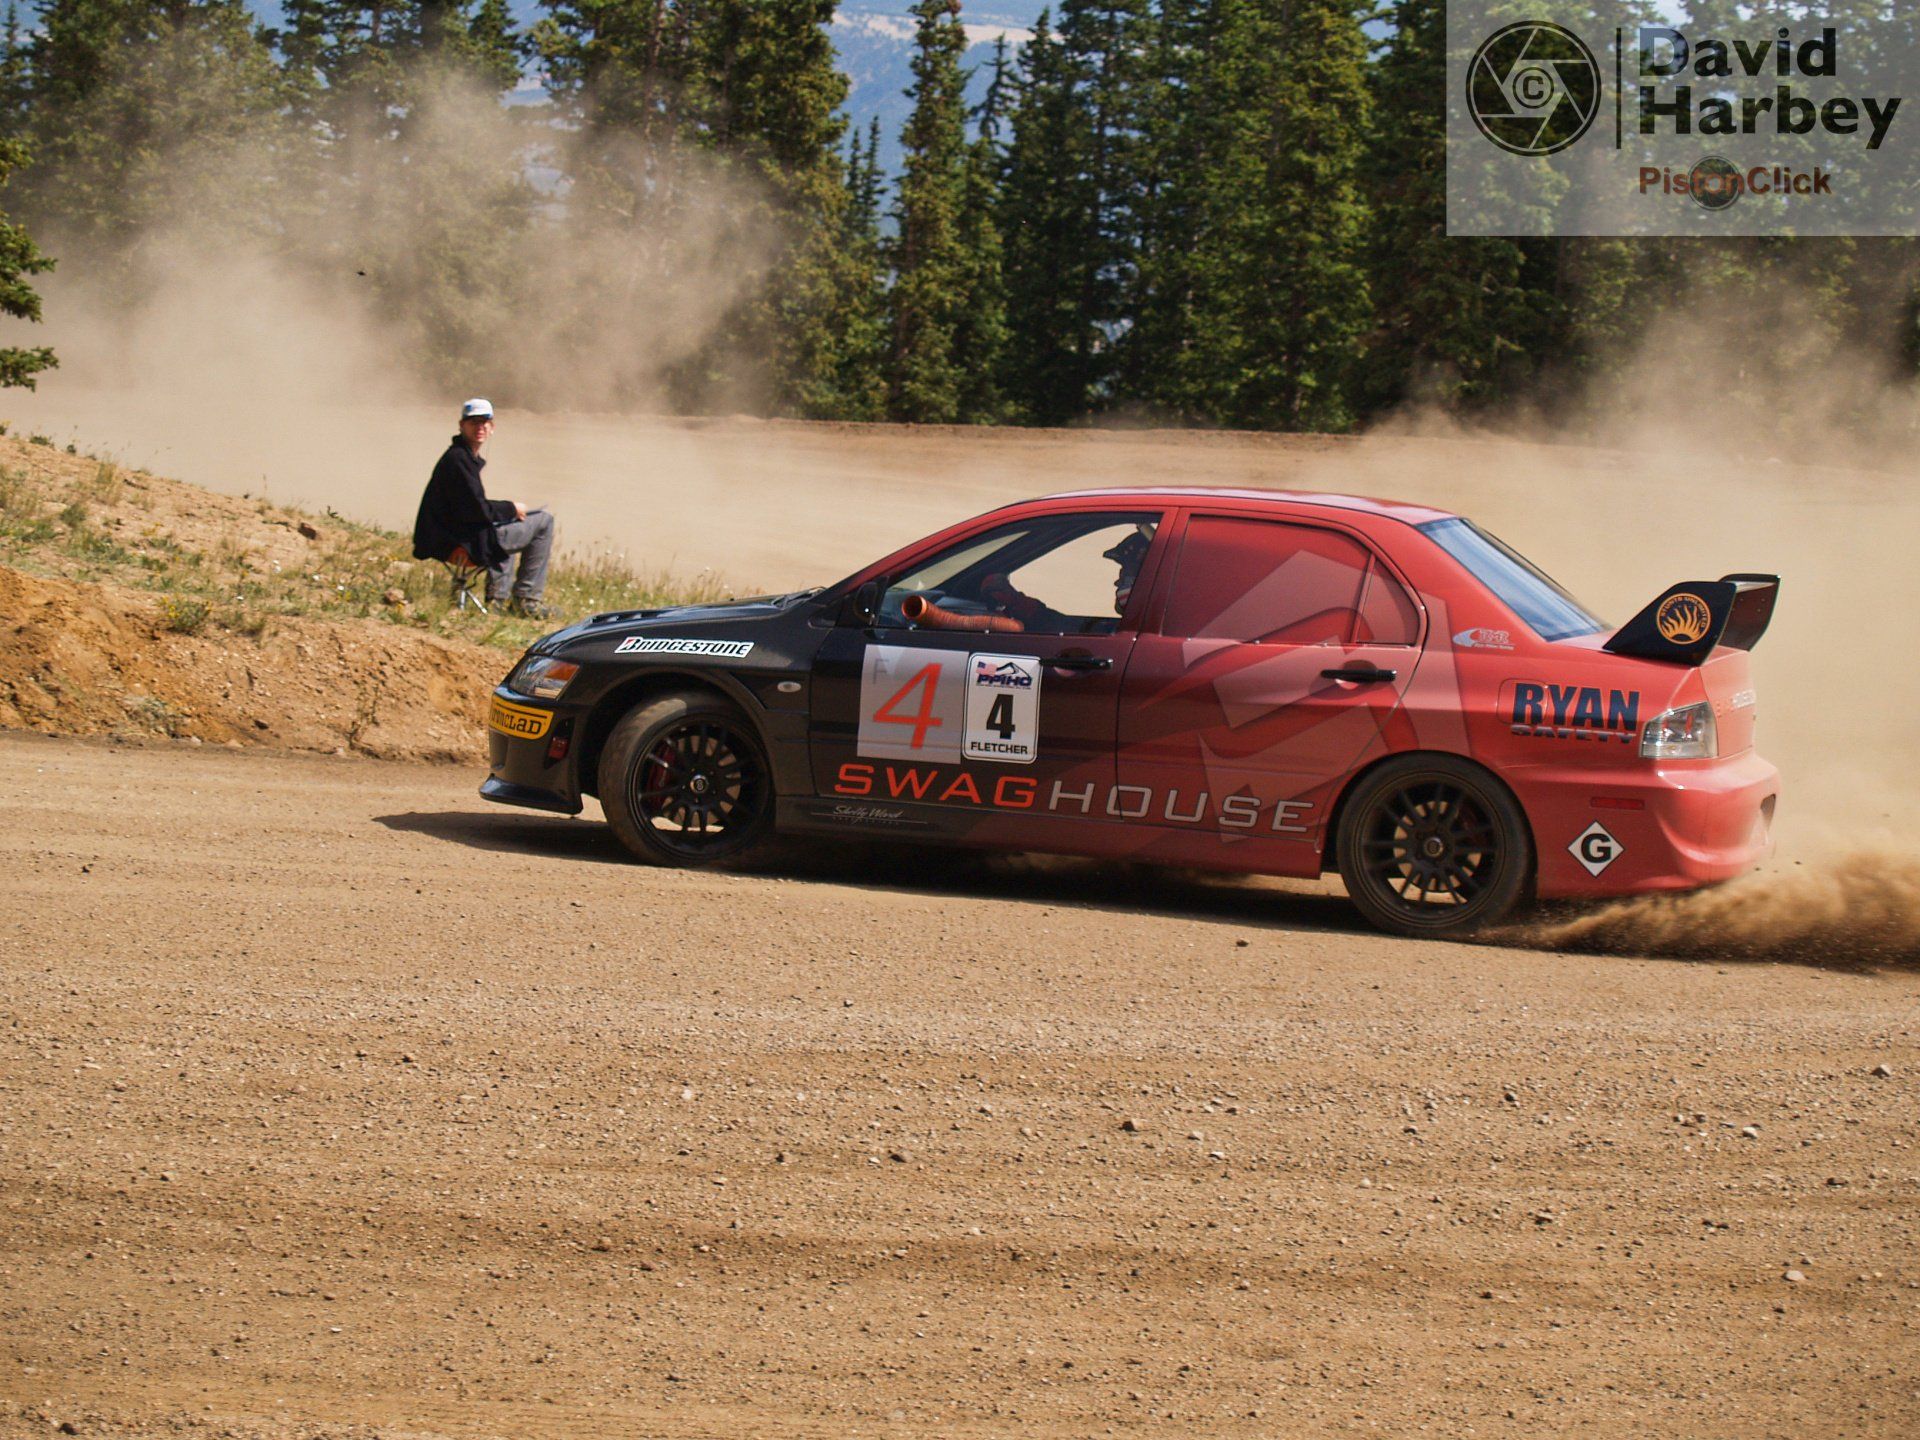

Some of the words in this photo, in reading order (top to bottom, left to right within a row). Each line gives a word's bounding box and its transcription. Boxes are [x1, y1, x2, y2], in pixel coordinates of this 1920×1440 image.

[619, 638, 751, 656] BRIDGESTONE
[873, 662, 943, 750] 4
[986, 693, 1016, 740] 4
[1512, 683, 1640, 731] RYAN
[970, 741, 1029, 755] FLETCHER
[1580, 833, 1612, 864] G
